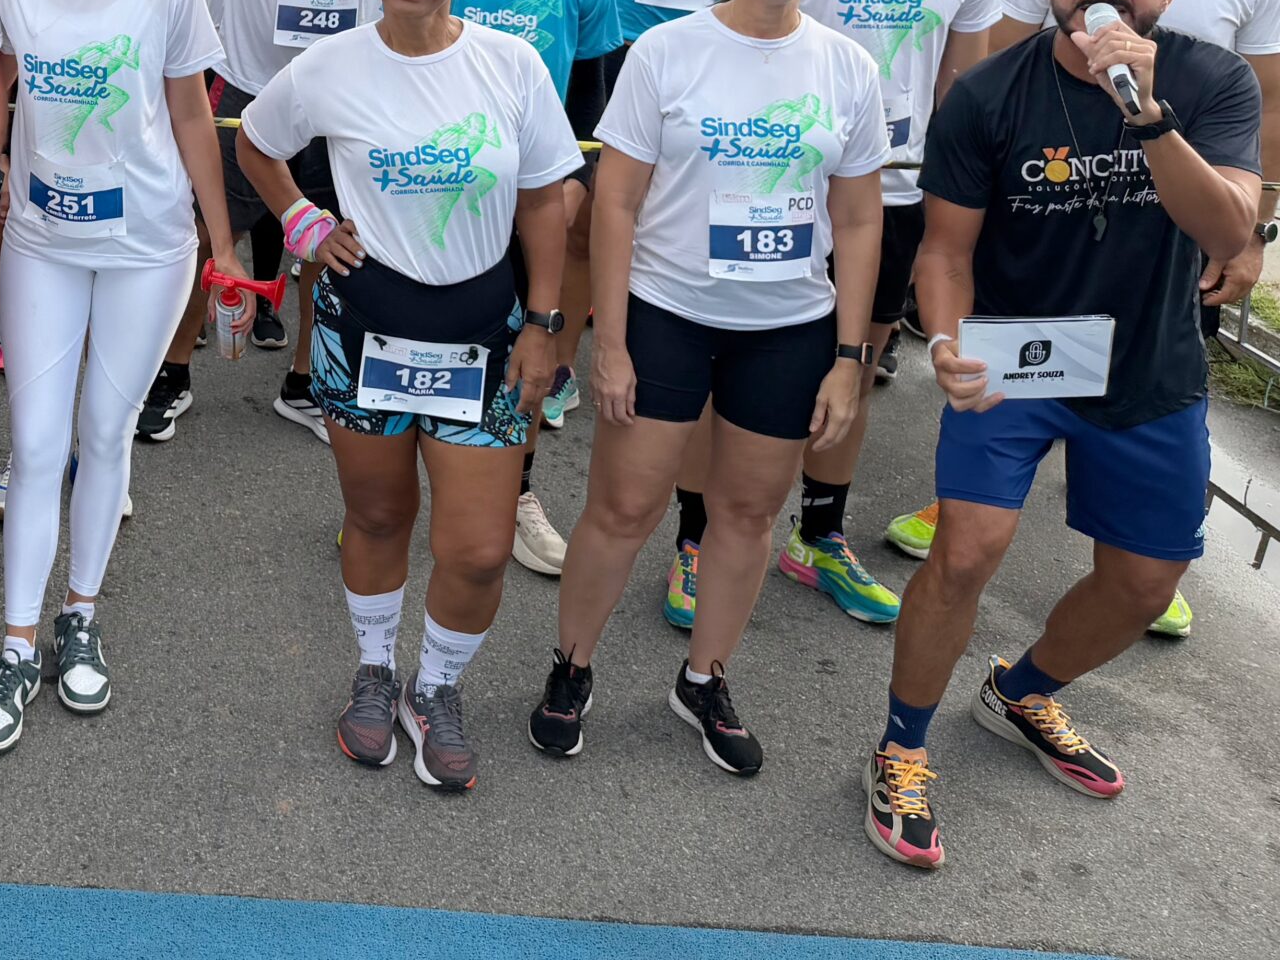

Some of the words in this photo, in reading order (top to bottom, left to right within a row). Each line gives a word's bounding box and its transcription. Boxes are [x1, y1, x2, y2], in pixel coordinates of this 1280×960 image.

[299, 9, 340, 29] 248
[463, 6, 538, 31] SindSeg
[23, 52, 108, 84] SindSeg
[33, 95, 58, 103] CORRIDA
[64, 97, 99, 106] CAMINHADA
[700, 117, 801, 144] SindSeg
[368, 144, 472, 169] SindSeg
[425, 186, 465, 194] CAMINHADA
[47, 189, 95, 215] 251
[788, 197, 814, 211] PCD
[68, 213, 97, 221] Barreto
[749, 206, 783, 215] SindSeg
[736, 229, 794, 253] 183
[749, 252, 783, 260] SIMONE
[409, 349, 443, 360] SindSeg
[396, 367, 452, 390] 182
[1003, 371, 1036, 380] ANDREY
[1036, 370, 1065, 379] SOUZA
[408, 387, 435, 395] MARIA
